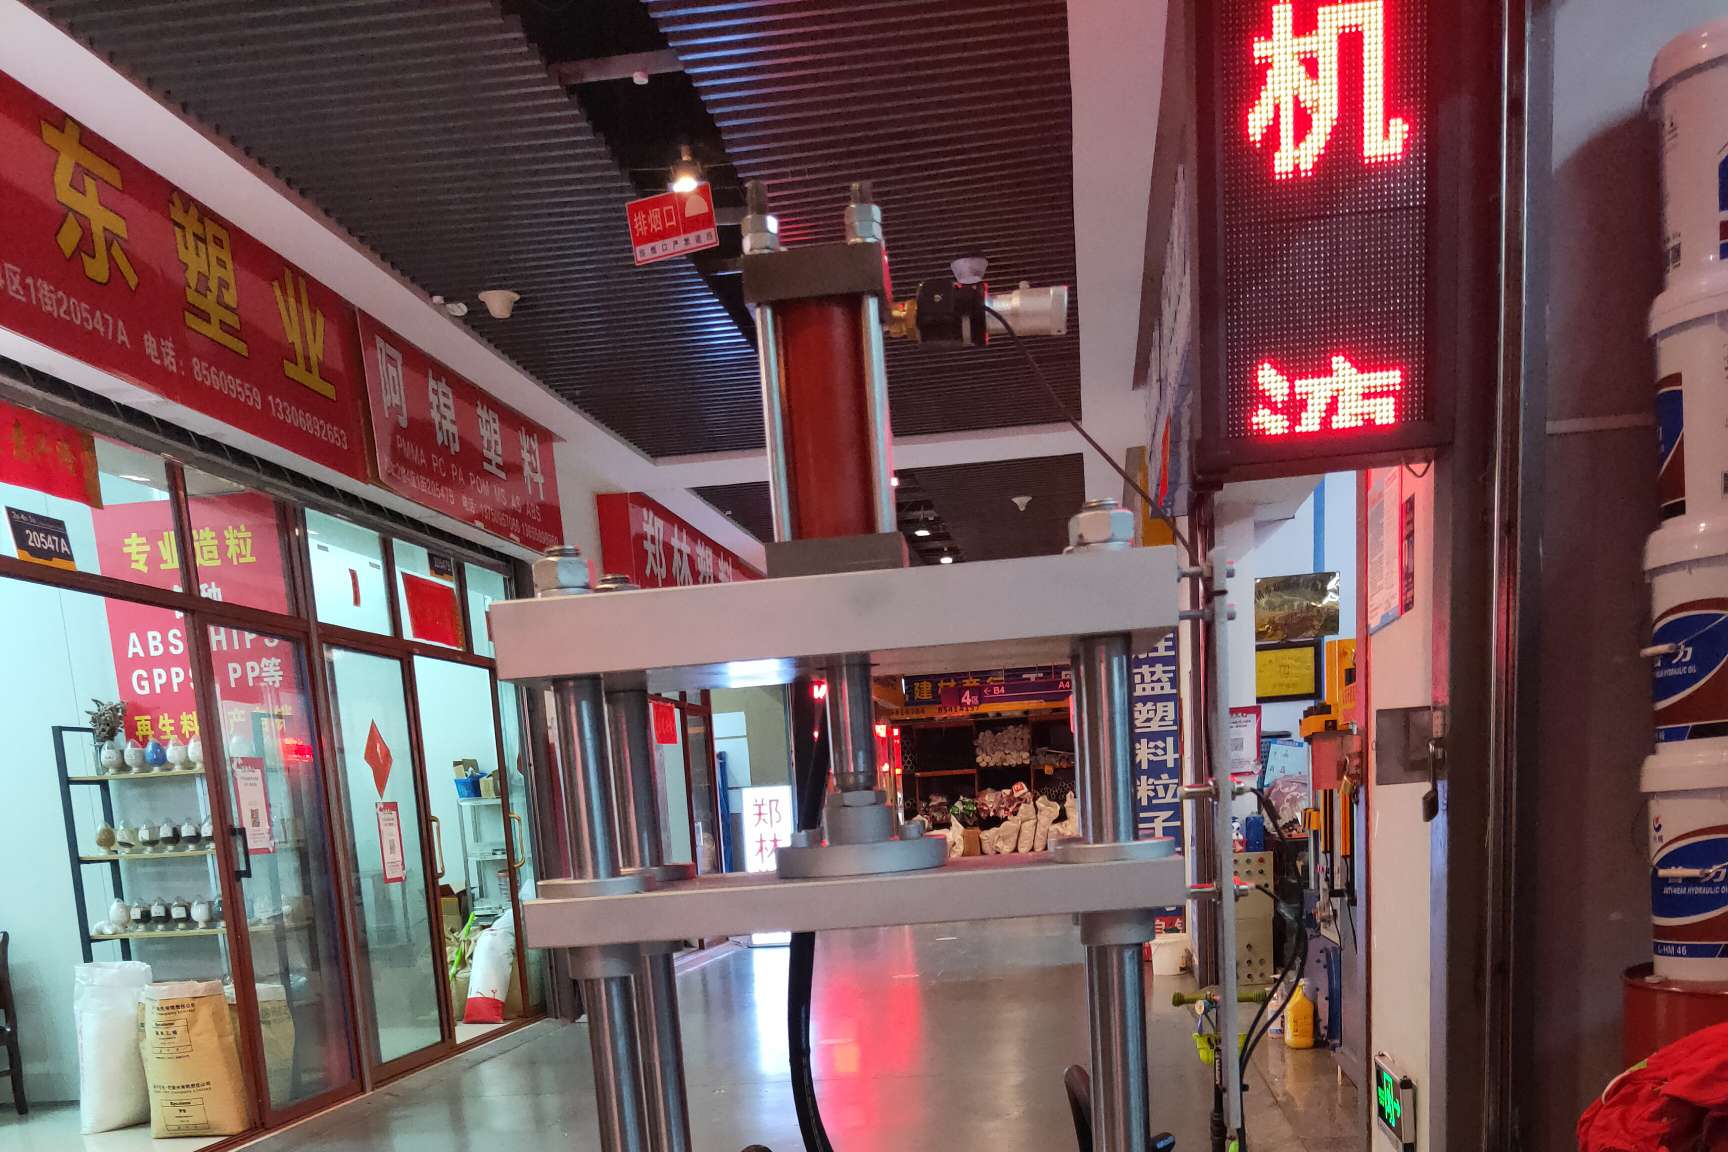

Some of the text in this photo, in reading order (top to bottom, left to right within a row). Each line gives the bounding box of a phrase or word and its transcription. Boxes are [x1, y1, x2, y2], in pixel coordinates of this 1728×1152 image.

[1248, 0, 1409, 178] 机
[634, 205, 676, 237] 排烟口
[40, 116, 336, 400] 东塑业
[0, 262, 130, 349] 区1街20547A
[192, 357, 262, 410] 85609559
[268, 395, 349, 450] 13306892653
[432, 454, 446, 477] PC
[452, 464, 465, 485] PA
[469, 472, 490, 498] POM
[25, 529, 71, 555] 20547A
[122, 523, 256, 573] 专业造粒
[128, 629, 184, 658] ABS
[131, 666, 195, 695] GPP
[993, 686, 1005, 695] B4
[1058, 681, 1071, 689] A4
[134, 711, 200, 742] 再生料
[753, 798, 782, 864] 郑林
[1687, 885, 1720, 895] HYDRAULIC
[1676, 945, 1687, 955] 46
